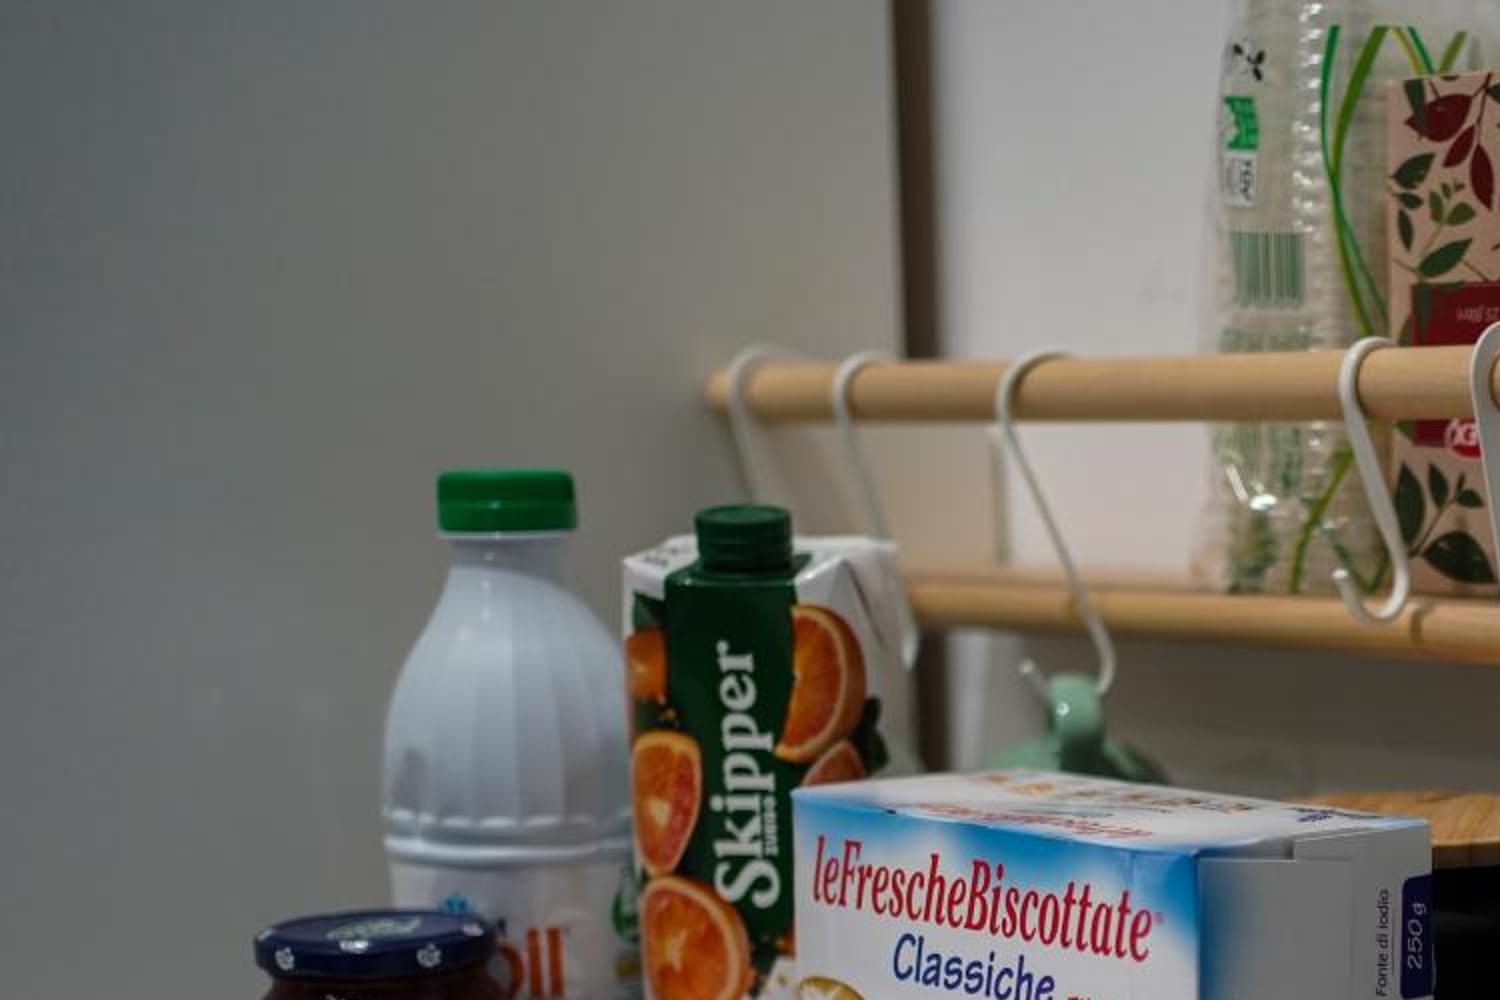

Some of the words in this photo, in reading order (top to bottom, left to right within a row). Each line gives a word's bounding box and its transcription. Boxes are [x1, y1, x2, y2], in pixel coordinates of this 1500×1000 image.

[711, 641, 781, 908] Skipper
[813, 833, 1153, 961] leFrescheBiscottate
[1375, 933, 1389, 949] di
[1375, 952, 1389, 997] Fonte
